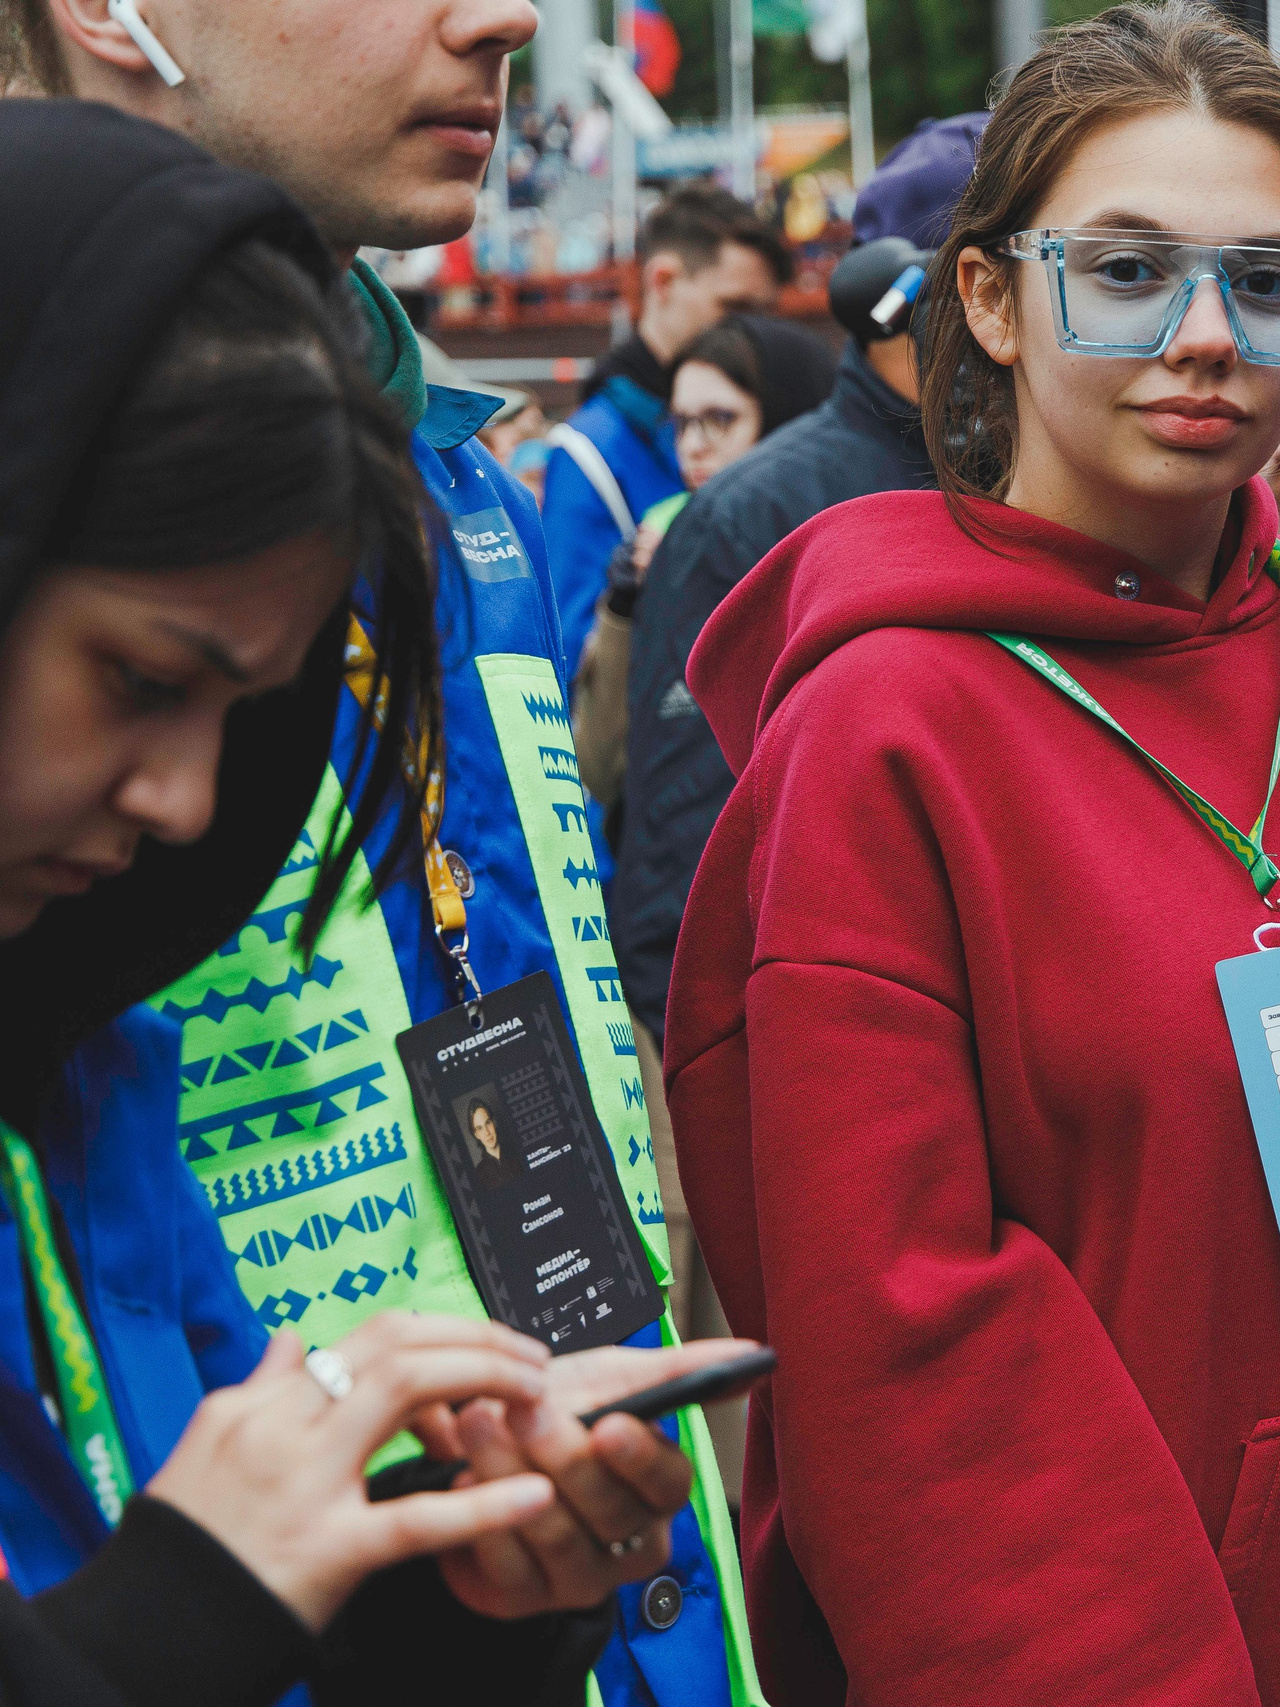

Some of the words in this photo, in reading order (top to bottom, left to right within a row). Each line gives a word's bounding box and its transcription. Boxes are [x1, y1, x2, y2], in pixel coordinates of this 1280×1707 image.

[461, 544, 521, 564] ВЕСНА
[437, 1016, 523, 1062] СТУДВЕСНА
[523, 1194, 551, 1214] Роман
[522, 1207, 564, 1233] Самсонов
[536, 1249, 580, 1277] МЕДИА-
[536, 1258, 590, 1294] ВОЛОНТЁР
